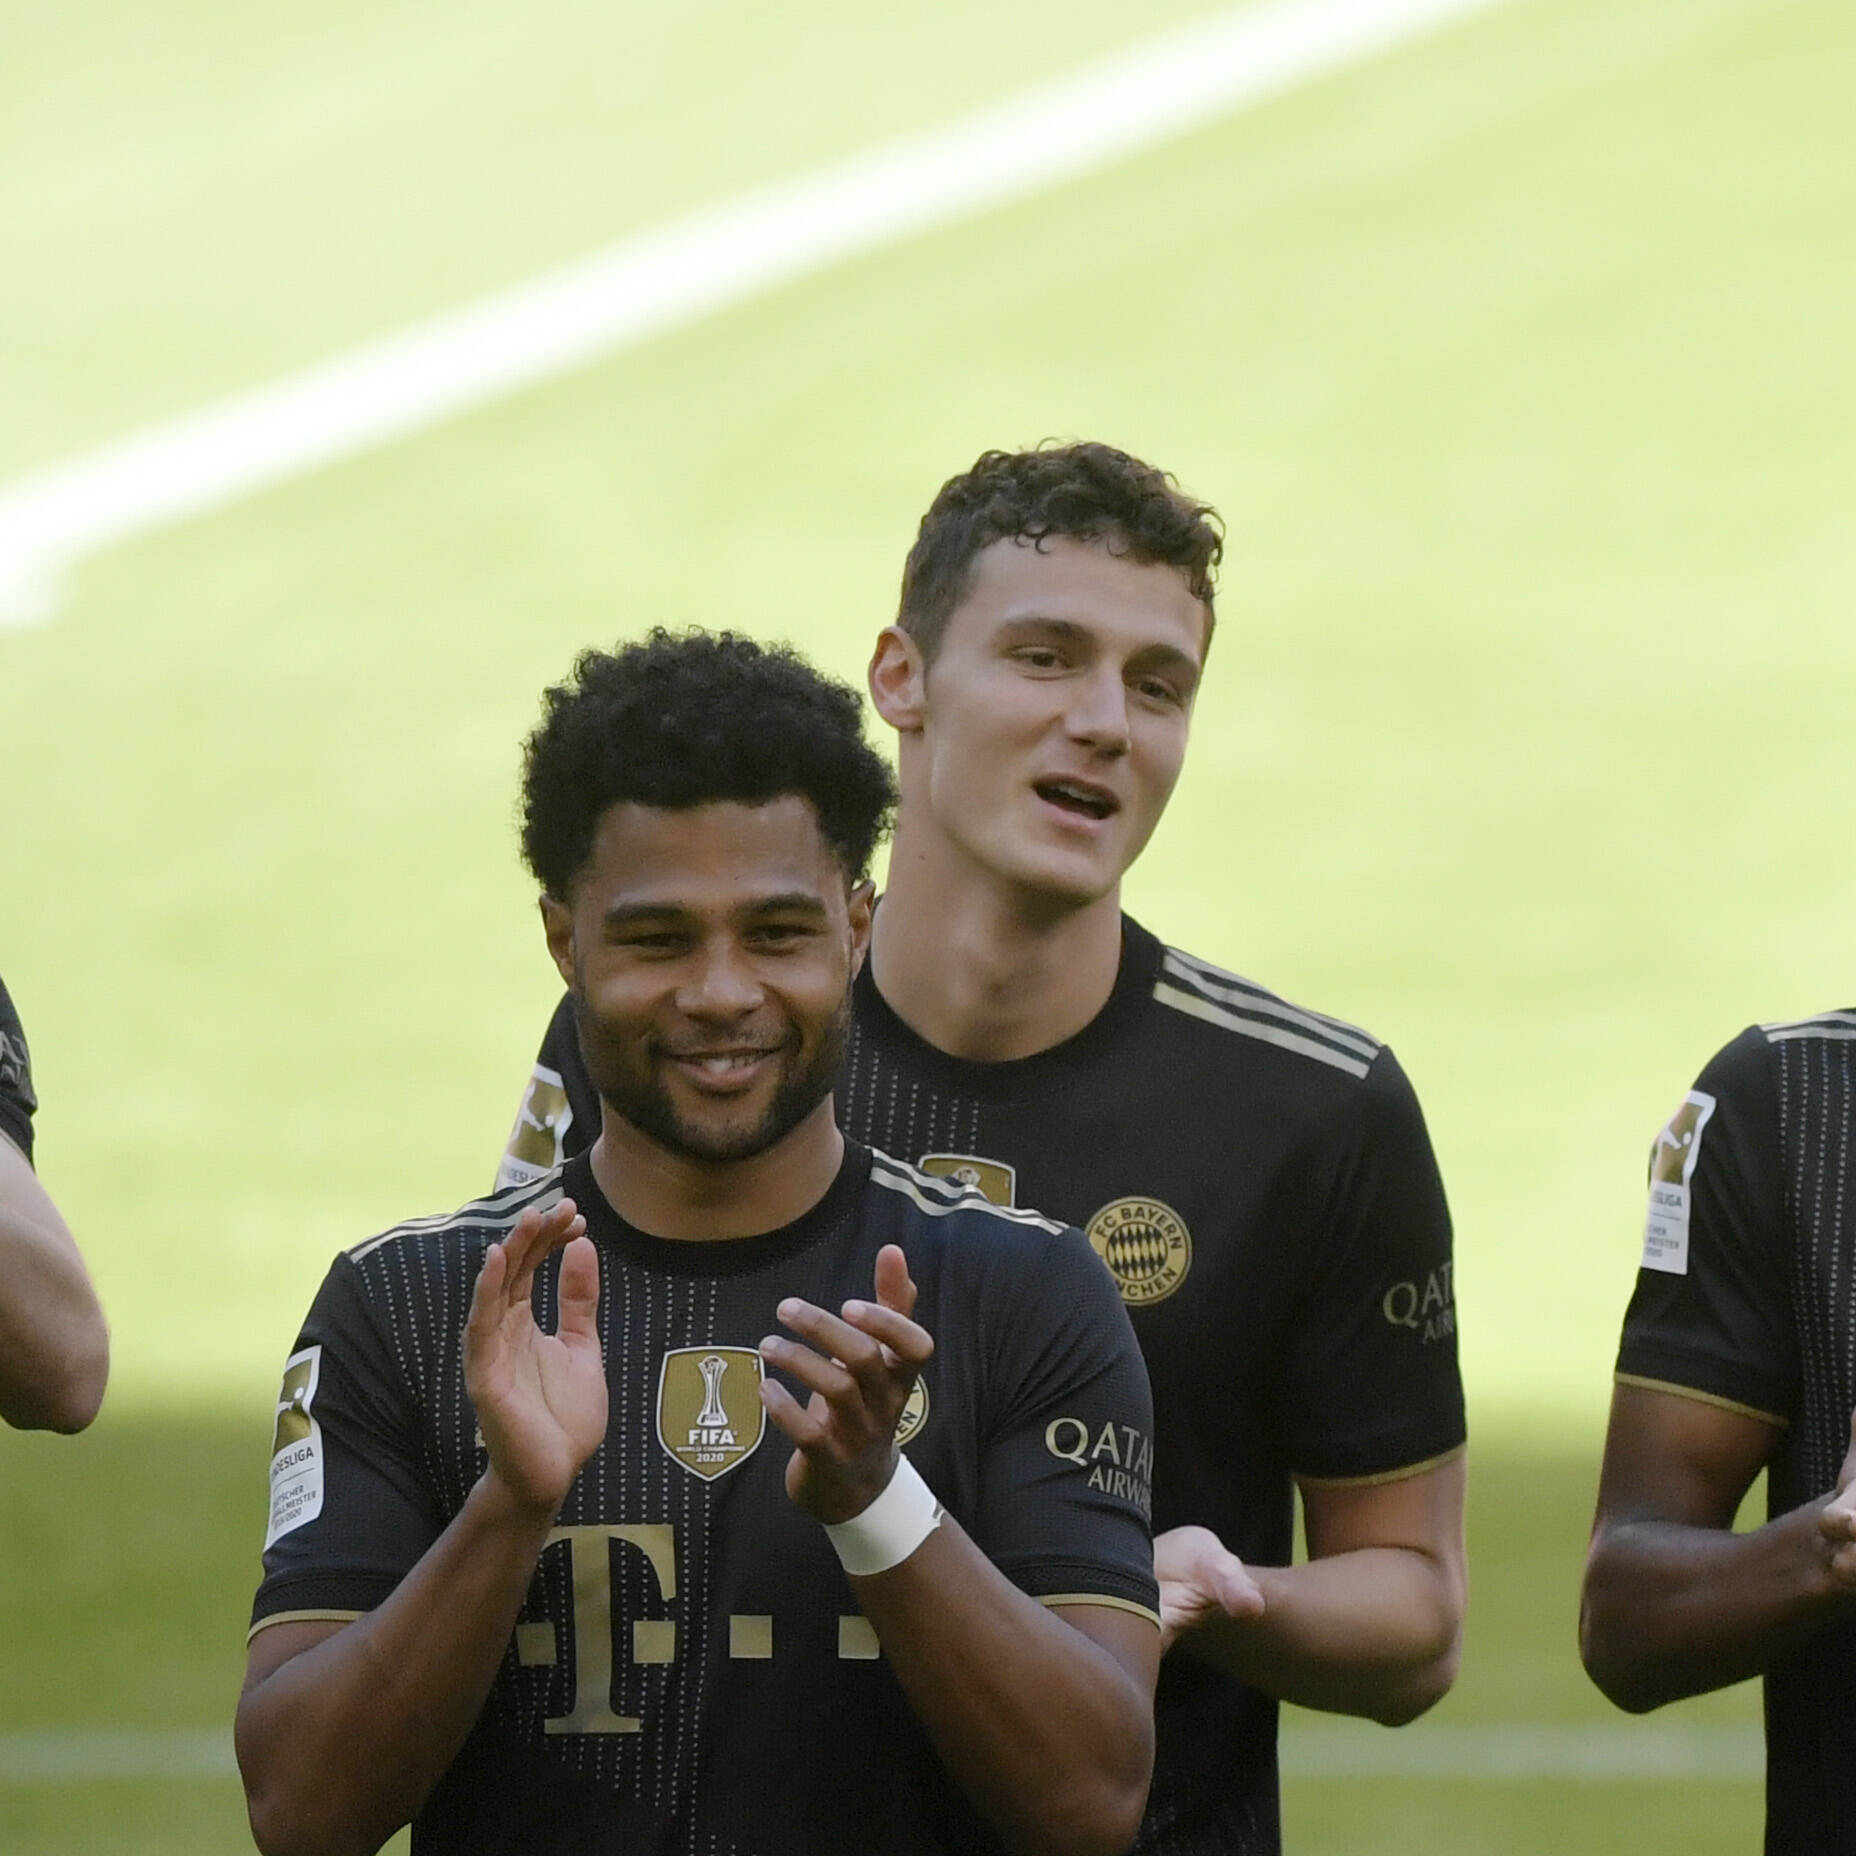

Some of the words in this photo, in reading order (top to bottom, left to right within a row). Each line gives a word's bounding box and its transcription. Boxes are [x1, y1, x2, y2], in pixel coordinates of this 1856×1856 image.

[1095, 1215, 1117, 1238] FC
[1121, 1206, 1183, 1250] BAYERN
[1383, 1261, 1451, 1328] QAT
[688, 1429, 736, 1445] FIFA
[696, 1453, 725, 1463] 2020
[1045, 1417, 1153, 1482] QATA
